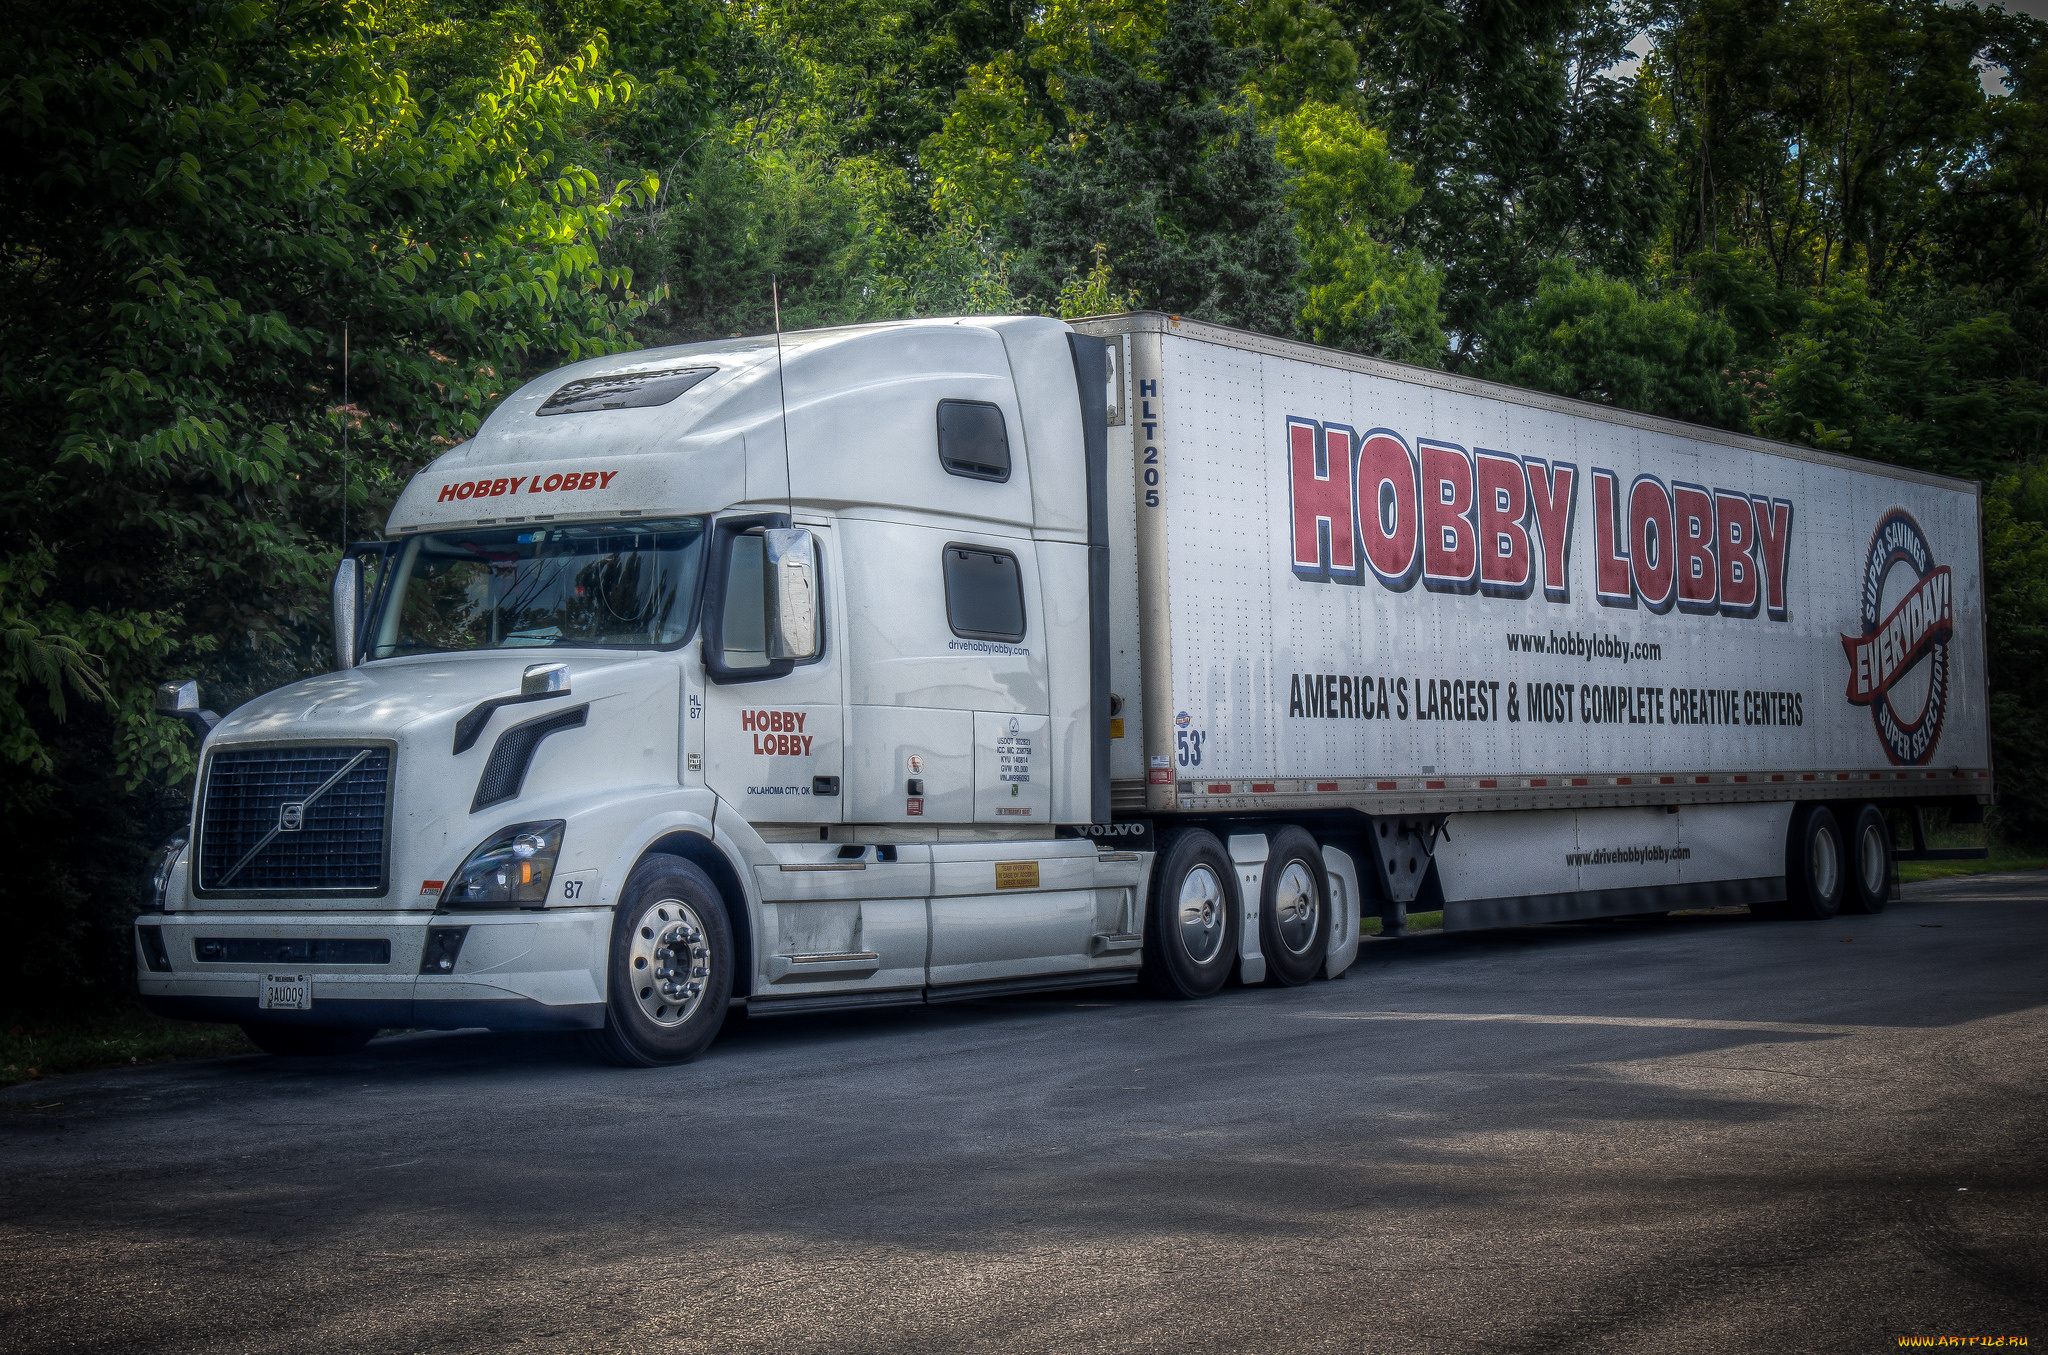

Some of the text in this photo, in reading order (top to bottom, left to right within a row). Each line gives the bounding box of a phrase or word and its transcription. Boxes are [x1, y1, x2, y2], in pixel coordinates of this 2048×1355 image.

[1140, 379, 1160, 508] HLT 205
[437, 471, 619, 503] HOBBY LOBBY
[1286, 415, 1794, 622] HOBBY LOBBY
[1865, 521, 1927, 624] SUPER SAVINGS
[948, 639, 1030, 656] drivehobbylobby.com
[1507, 629, 1662, 664] www.hobbylobby.com
[1856, 572, 1949, 695] EVERYDAY!
[689, 694, 702, 706] HL
[690, 707, 702, 719] 87
[1289, 673, 1803, 727] AMERICA'S LARGEST & MOST COMPLETE CREATIVE CENTERS
[1879, 645, 1944, 761] SUPER SELECTION
[741, 709, 807, 733] HOBBY
[753, 733, 813, 756] LOBBY
[1177, 730, 1206, 767] 53'
[747, 786, 811, 796] OKLAHOMA CITY, OK
[1073, 823, 1145, 836] VOLVO
[1565, 846, 1691, 867] www.drivehobbylobby.com
[564, 880, 584, 899] 87
